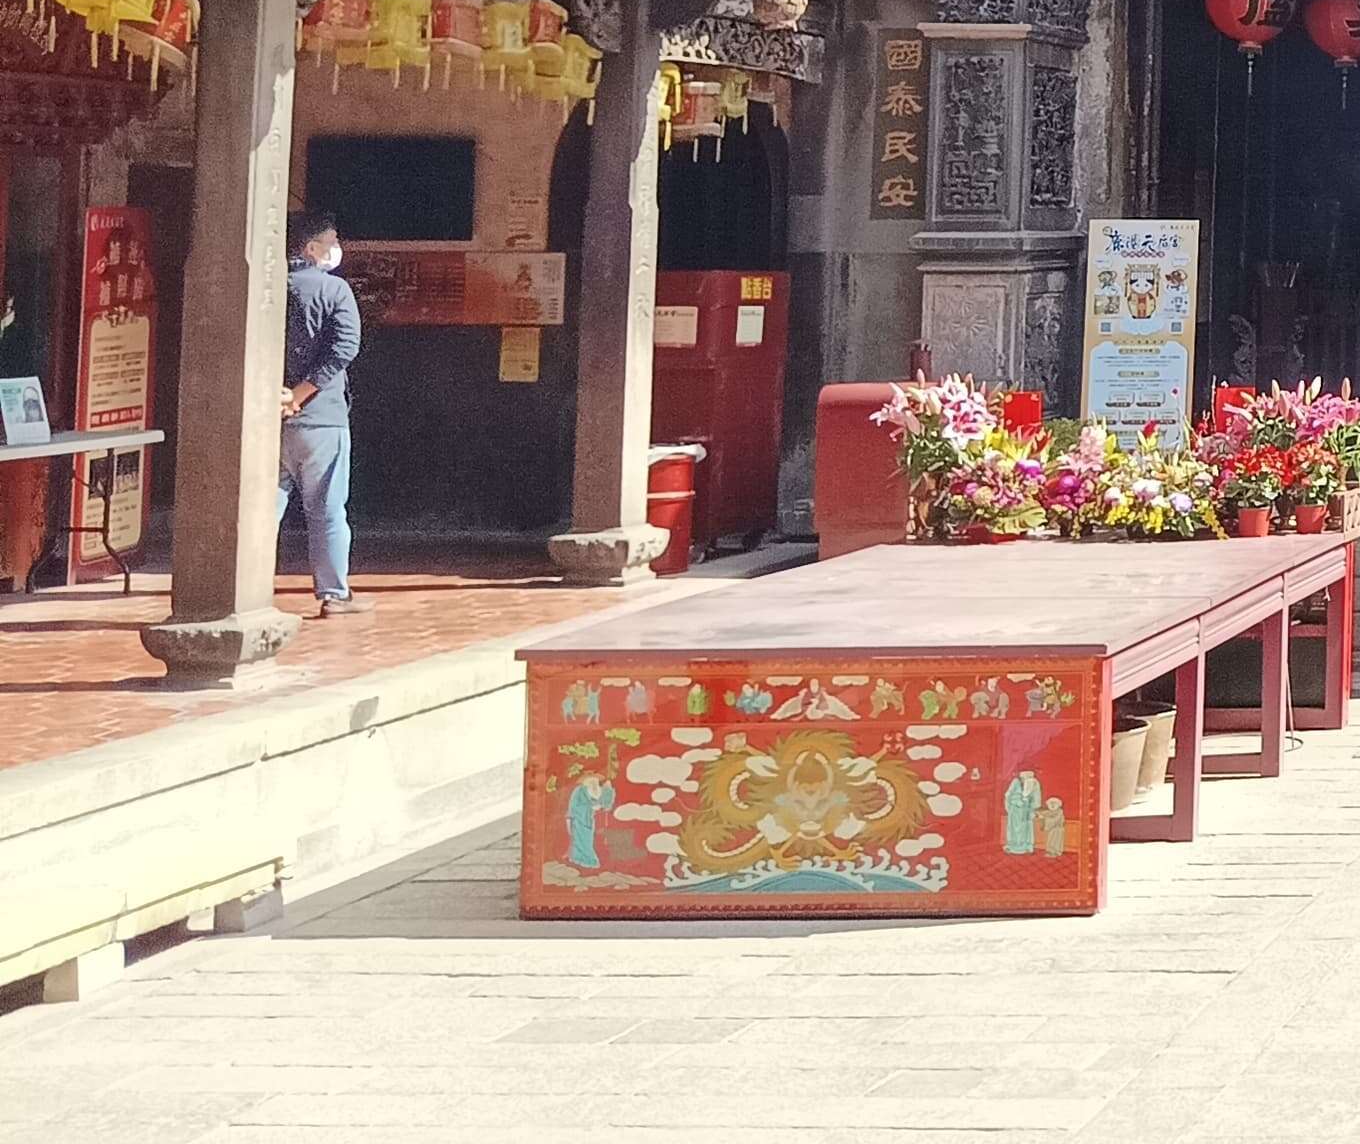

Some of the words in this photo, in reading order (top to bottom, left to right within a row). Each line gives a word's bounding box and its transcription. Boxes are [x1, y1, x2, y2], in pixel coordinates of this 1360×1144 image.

[879, 39, 923, 207] 國泰民安
[741, 277, 772, 300] 點香台
